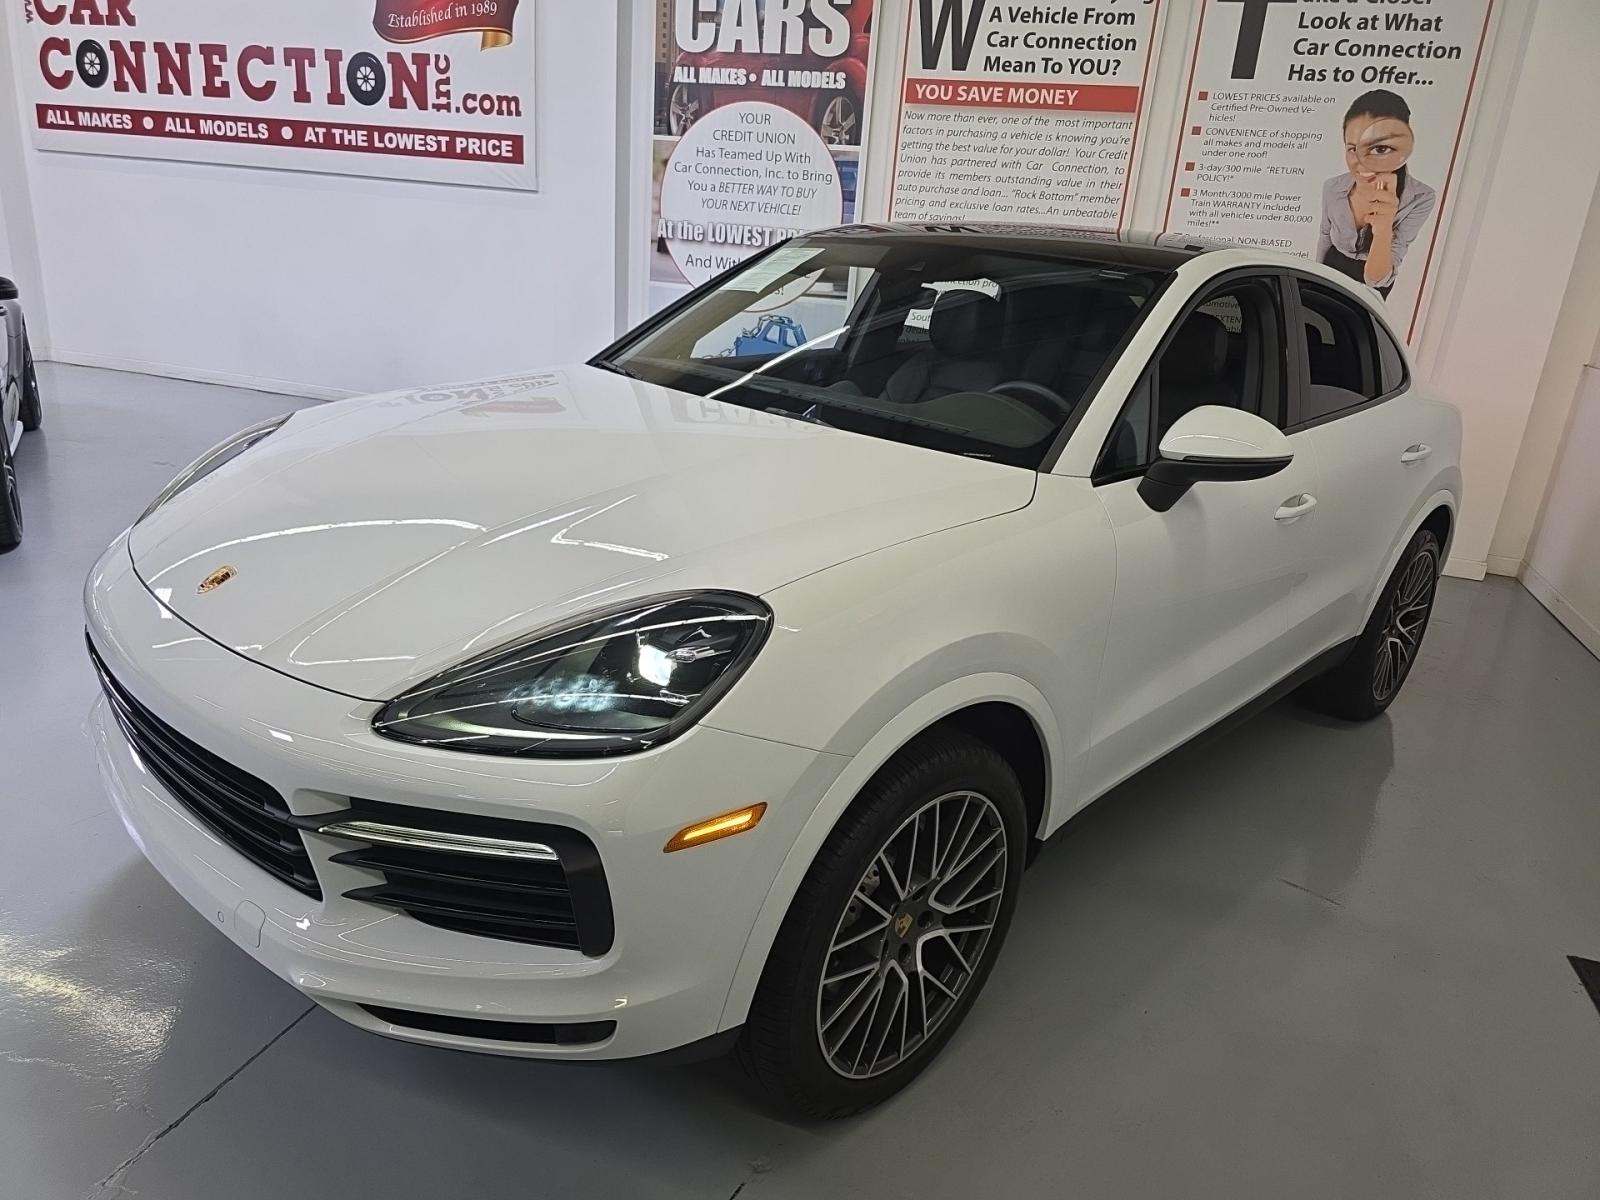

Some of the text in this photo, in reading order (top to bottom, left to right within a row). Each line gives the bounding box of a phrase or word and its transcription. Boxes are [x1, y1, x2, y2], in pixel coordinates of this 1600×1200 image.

[388, 1, 497, 28] Established in 1989
[989, 7, 1135, 25] A Vehicle From
[1298, 11, 1443, 32] Look at What
[675, 0, 850, 57] CARS
[987, 31, 1137, 51] Car Connection
[1293, 38, 1462, 60] Car Connection
[984, 56, 1121, 76] Mean To YOU?
[1288, 64, 1434, 86] Has to Offer...
[40, 37, 430, 110] CONNECTION
[456, 93, 522, 117] .com
[673, 66, 846, 89] ALL MAKES ALL MODELS
[916, 84, 1079, 105] YOU SAVE MONEY
[1251, 93, 1280, 101] PRICES
[1282, 95, 1322, 103] available
[1211, 103, 1247, 112] Certified
[1250, 105, 1299, 113] Pre-Owned
[739, 112, 771, 125] YOUR
[904, 111, 925, 120] Now
[927, 113, 951, 122] more
[954, 113, 975, 123] than
[977, 117, 998, 125] ever,
[1022, 115, 1033, 126] of
[1035, 116, 1049, 126] the
[1055, 119, 1080, 127] most
[1082, 119, 1133, 130] important
[46, 109, 513, 157] ALL MAKES ALL MODELS AT THE LOWEST PRICE
[713, 130, 796, 144] CREDIT UNION
[902, 125, 933, 135] factors
[936, 127, 944, 136] in
[947, 129, 998, 141] purchasing
[1010, 131, 1043, 141] vehicle
[1045, 133, 1052, 141] is
[1055, 132, 1098, 145] knowing
[1205, 128, 1323, 141] CONVENIENCE of shopping
[901, 141, 1128, 159] getting the best value for your dollar! Your Credit
[1204, 138, 1214, 146] all
[1216, 139, 1242, 147] makes
[1245, 140, 1261, 148] and
[1263, 141, 1295, 149] models
[696, 147, 811, 164] Has Teamed Up With
[900, 154, 1125, 175] Union has partnered with Car Connection, to
[674, 162, 832, 185] Car Connection, Inc. to Bring
[897, 169, 1123, 189] provide its members outstanding value in their
[688, 180, 818, 199] You a BETTER WAY TO BUY
[918, 184, 959, 194] purchase
[961, 187, 979, 196] and
[1079, 194, 1120, 204] member
[1200, 190, 1252, 199] Month/3000
[1253, 192, 1272, 200] mile
[1274, 193, 1302, 201] Power
[701, 198, 802, 216] YOUR NEXT VEHICLE!
[895, 197, 925, 208] pricing
[929, 199, 947, 207] and
[950, 200, 989, 210] exclusive
[992, 203, 1013, 212] loan
[1062, 208, 1118, 219] unbeatable
[1191, 199, 1301, 212] Train WARRANTY included
[894, 211, 916, 220] team
[919, 212, 927, 221] of
[1221, 212, 1254, 220] vehicles
[1284, 215, 1313, 223] 80,000
[658, 218, 674, 239] At
[678, 220, 703, 241] the
[707, 222, 772, 247] LOWEST
[1237, 237, 1292, 248] NON-BIASED
[685, 254, 712, 268] And
